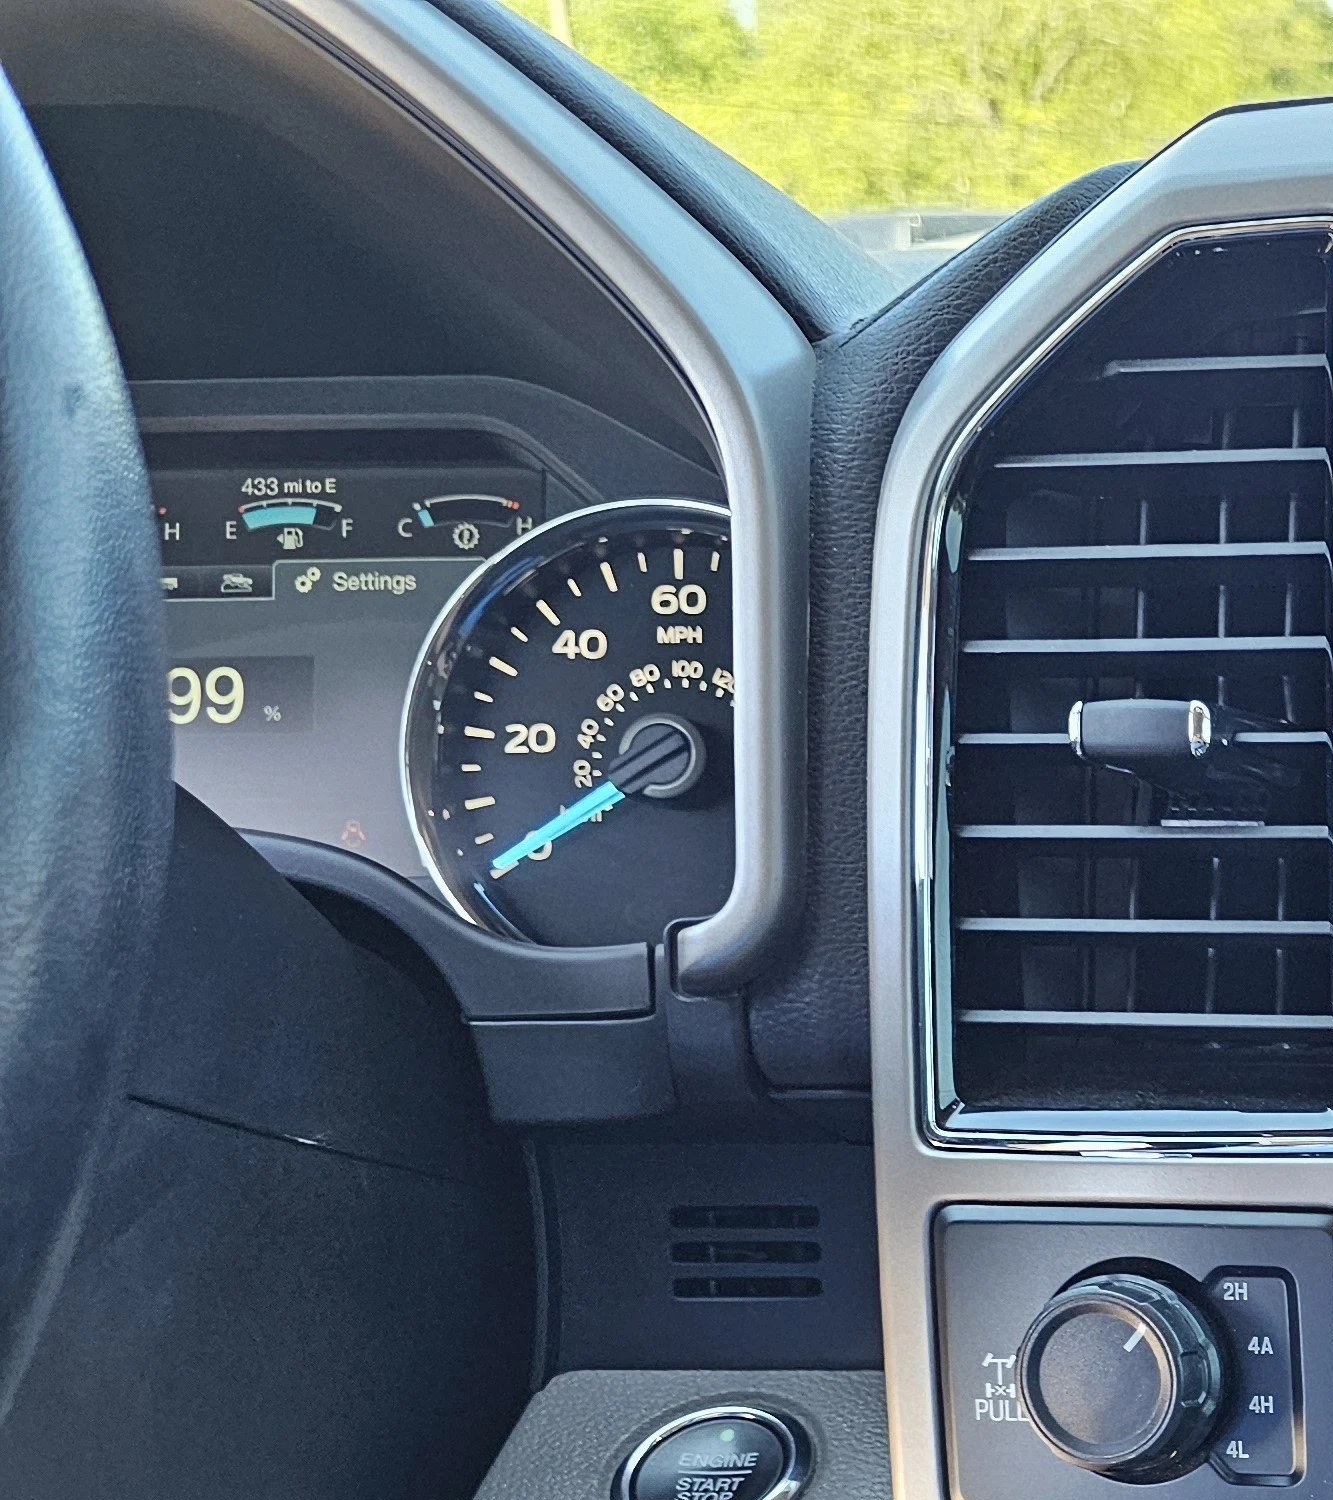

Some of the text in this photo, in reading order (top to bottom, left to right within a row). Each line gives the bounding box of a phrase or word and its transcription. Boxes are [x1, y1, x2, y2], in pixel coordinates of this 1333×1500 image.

[241, 477, 337, 496] 433 mi to E
[164, 522, 180, 541] H
[225, 520, 237, 540] E
[341, 518, 354, 538] F
[397, 517, 413, 538] C
[516, 516, 533, 535] H
[332, 571, 417, 595] Settings
[651, 584, 707, 615] 60
[552, 629, 608, 660] 40
[656, 625, 703, 644] MPH
[629, 663, 661, 687] 80
[671, 659, 704, 679] 100
[711, 667, 735, 694] 12
[168, 667, 282, 724] 99 %
[596, 684, 625, 712] 60
[504, 723, 556, 754] 20
[577, 718, 600, 750] 40
[573, 759, 593, 788] 20
[1222, 1282, 1248, 1301] 2H
[1247, 1336, 1274, 1355] 4A
[974, 1398, 1030, 1422] PULL
[1248, 1395, 1274, 1414] 4H
[1226, 1440, 1249, 1459] 4L
[678, 1452, 759, 1468] ENGINE
[675, 1477, 745, 1492] START
